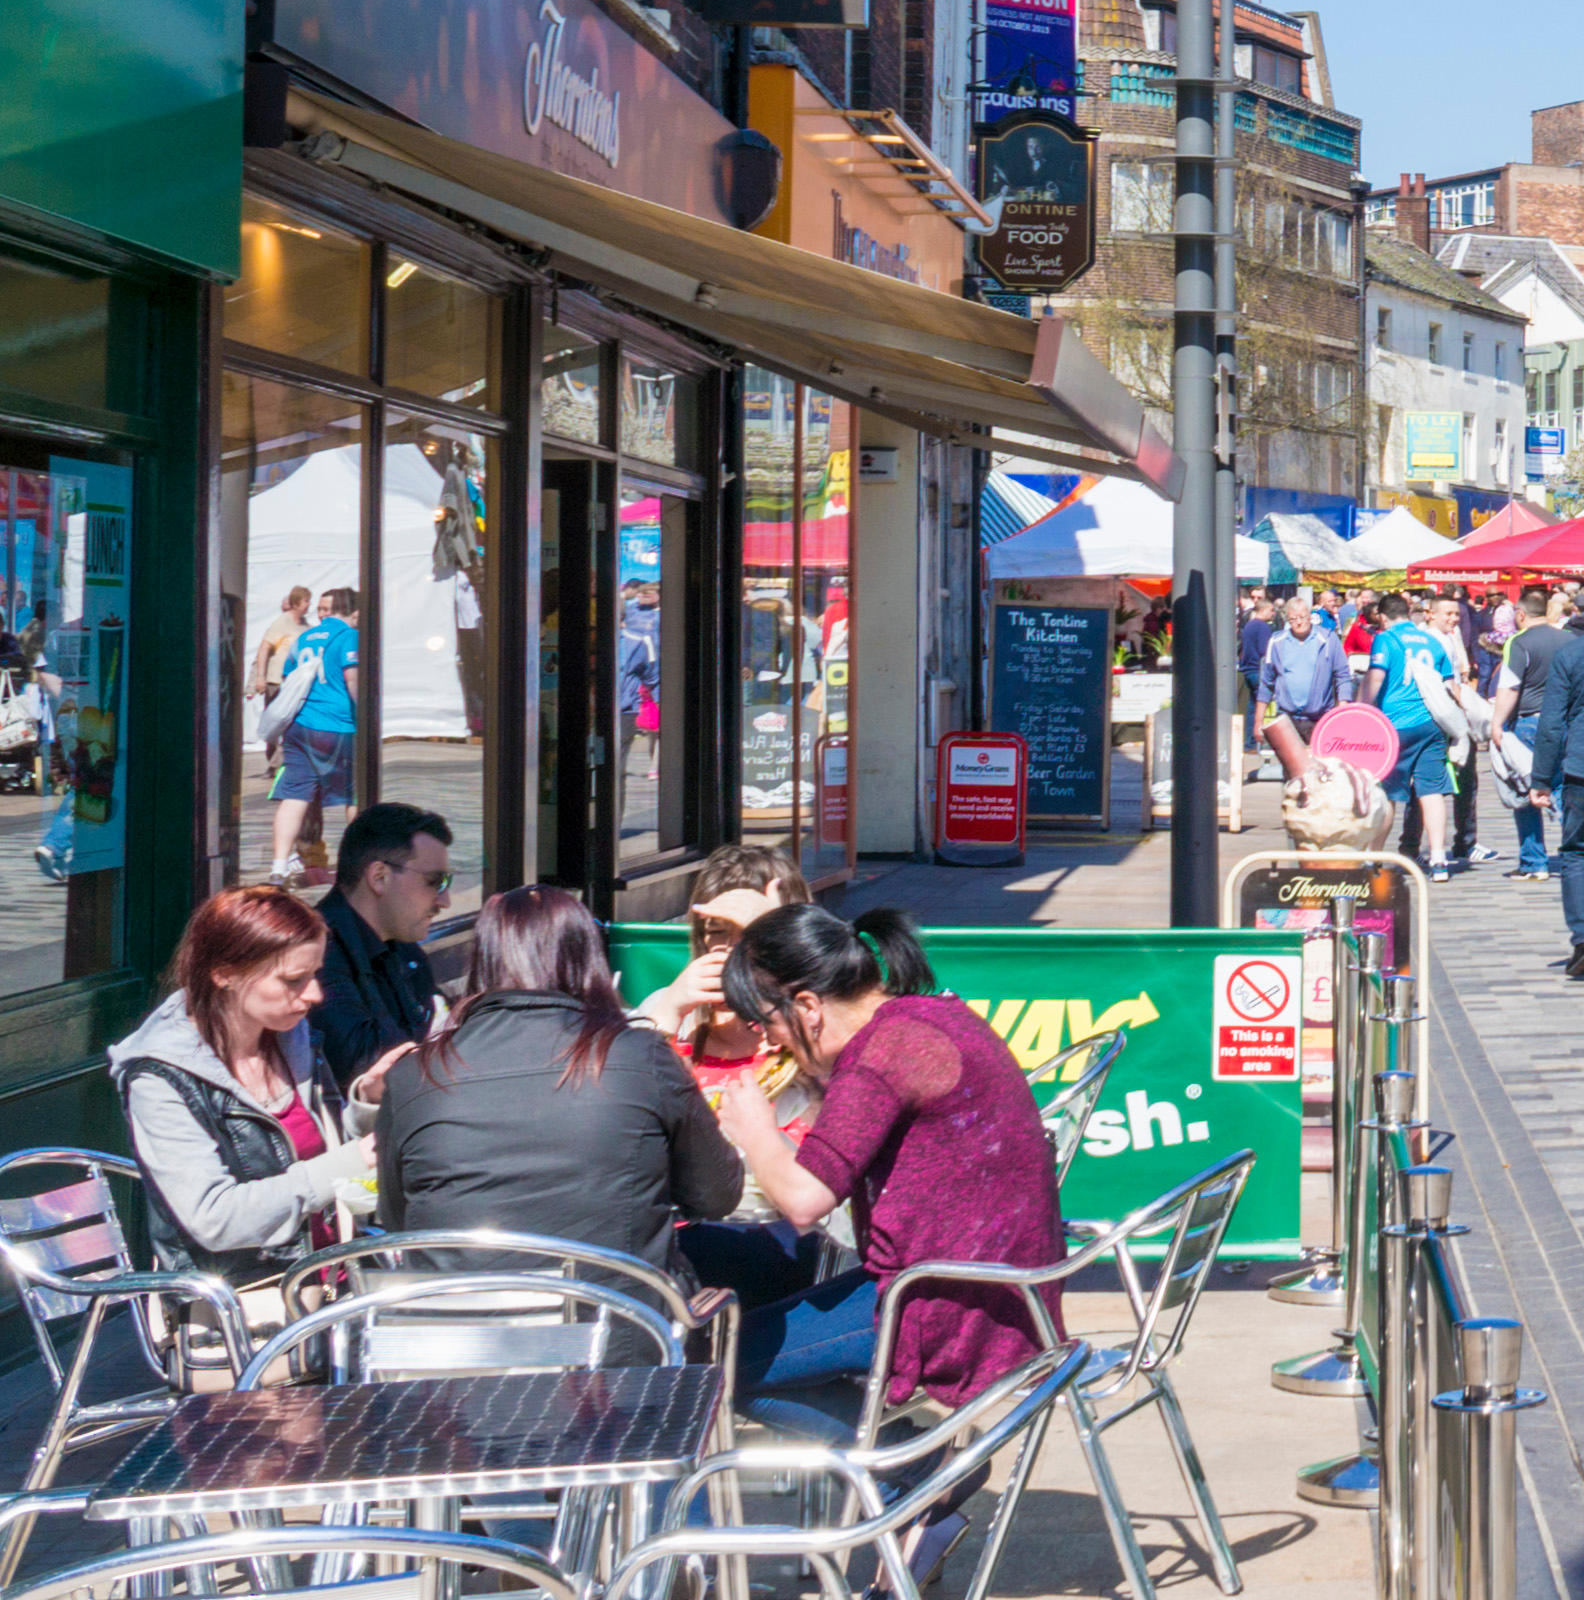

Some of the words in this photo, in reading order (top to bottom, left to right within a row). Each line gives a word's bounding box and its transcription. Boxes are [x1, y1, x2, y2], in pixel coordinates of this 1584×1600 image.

[1002, 203, 1078, 216] ONTINE
[1008, 230, 1064, 245] FOOD
[1004, 253, 1030, 266] Live
[1031, 254, 1063, 272] Sport
[1432, 415, 1458, 425] LET
[1007, 610, 1037, 626] The
[1040, 612, 1089, 629] Tontine
[1025, 627, 1079, 643] Kitchen
[1325, 736, 1386, 753] Thorntons
[1041, 781, 1076, 797] Town
[1230, 1029, 1260, 1042] This
[1261, 1029, 1274, 1042] is
[1274, 1031, 1285, 1042] a
[1220, 1046, 1238, 1057] no
[1239, 1045, 1294, 1060] smoking
[1242, 1061, 1272, 1072] area
